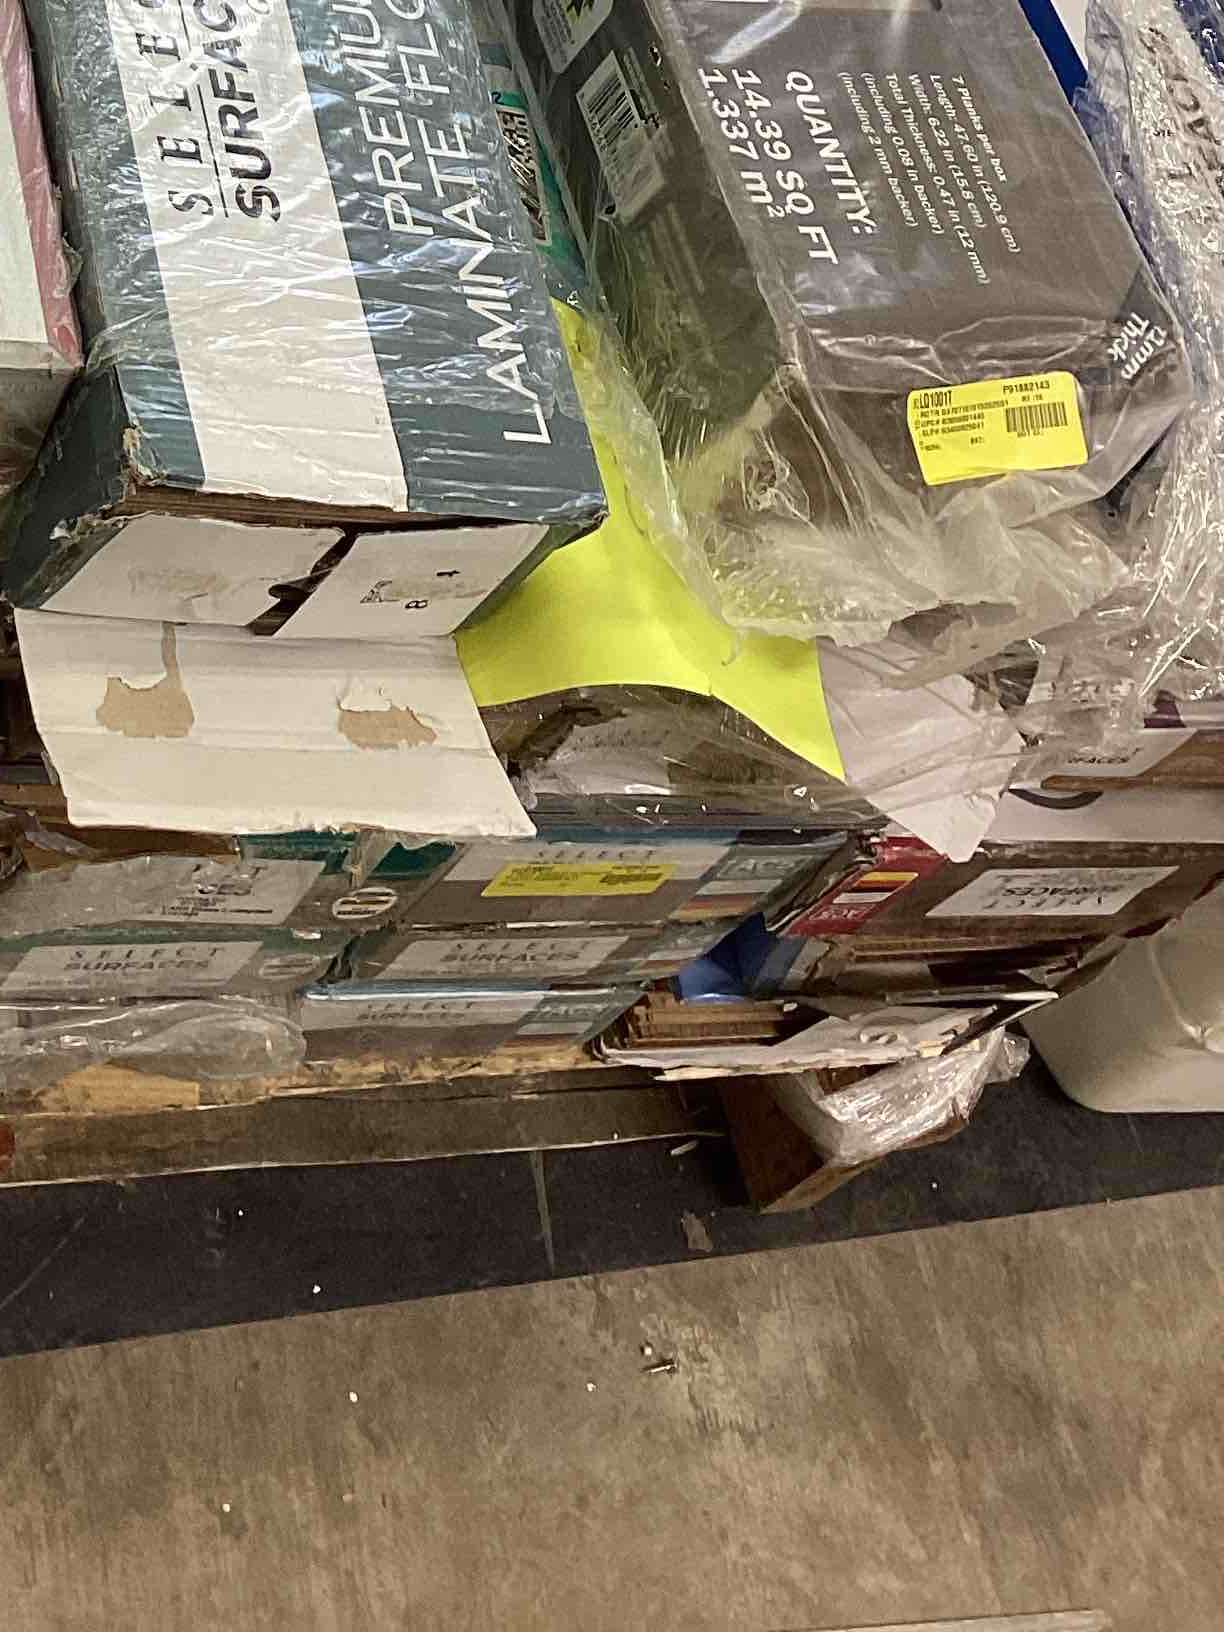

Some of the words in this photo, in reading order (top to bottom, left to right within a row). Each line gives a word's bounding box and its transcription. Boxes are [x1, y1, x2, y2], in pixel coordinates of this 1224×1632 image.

[885, 72, 908, 106] Total
[907, 72, 933, 116] Width:
[928, 73, 959, 122] Length:
[951, 74, 965, 86] 7
[696, 67, 761, 162] 1.337
[837, 71, 876, 135] (including
[860, 71, 899, 135] (including
[956, 86, 985, 132] Planks
[867, 134, 882, 146] 2
[900, 105, 938, 174] Thickness:
[927, 116, 950, 148] 6.22
[953, 122, 980, 164] 47.60
[976, 131, 996, 157] per
[730, 67, 793, 162] 14.39
[774, 168, 817, 217] SQ
[797, 223, 840, 266] FT
[784, 69, 879, 236] QUANTITY:
[873, 146, 894, 176] mm
[891, 134, 915, 168] 0.08
[942, 148, 956, 163] in
[906, 167, 920, 183] in
[947, 163, 975, 201] (15.8
[971, 164, 985, 179] in
[989, 156, 1009, 185] box
[887, 175, 920, 229] backer)
[912, 182, 946, 235] backer)
[932, 175, 956, 209] 0.47
[976, 179, 1009, 225] (120.9
[947, 208, 962, 223] in
[966, 200, 988, 229] cm)
[952, 223, 975, 249] (12
[999, 225, 1022, 254] cm)
[418, 116, 552, 448] LAMINATE
[966, 250, 991, 286] mm)
[1106, 310, 1151, 362] Thick
